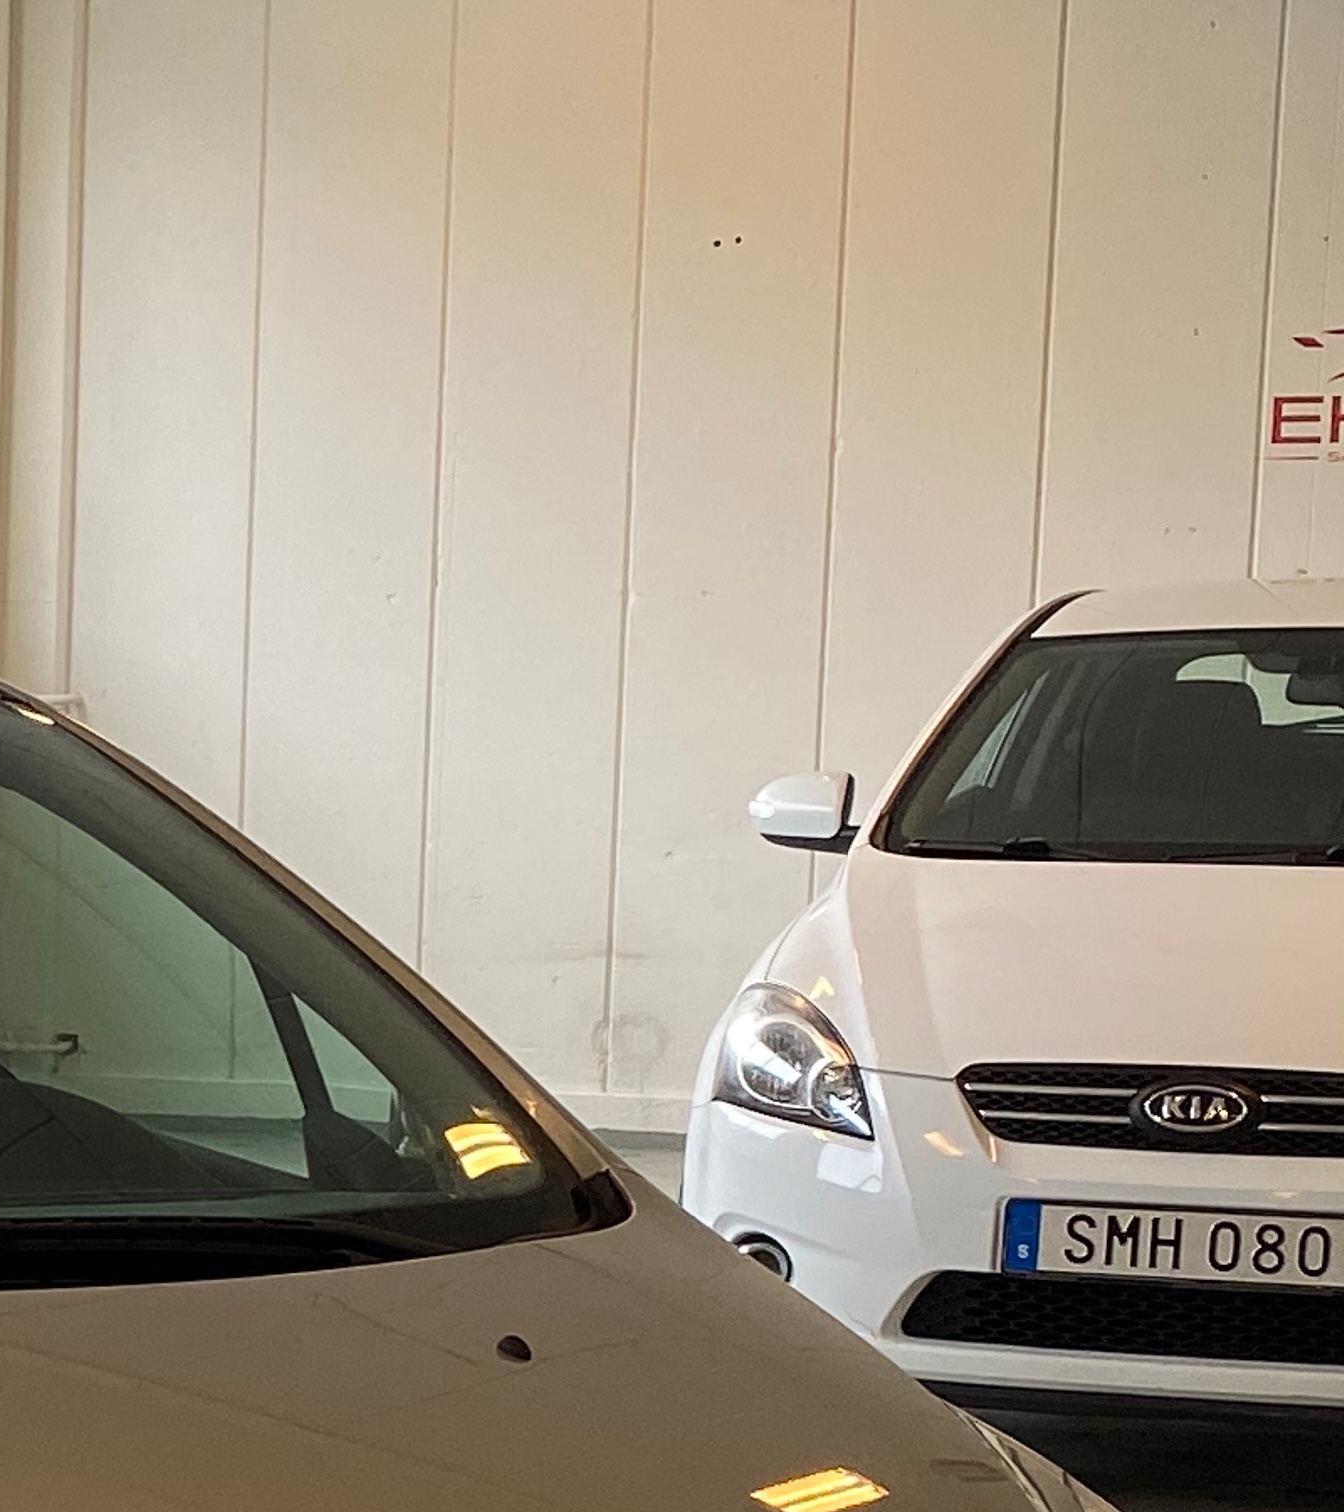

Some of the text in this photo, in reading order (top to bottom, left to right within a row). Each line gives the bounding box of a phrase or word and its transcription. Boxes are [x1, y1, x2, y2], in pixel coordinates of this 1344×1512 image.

[1162, 1095, 1229, 1121] KIA
[1064, 1214, 1332, 1277] SMH 080
